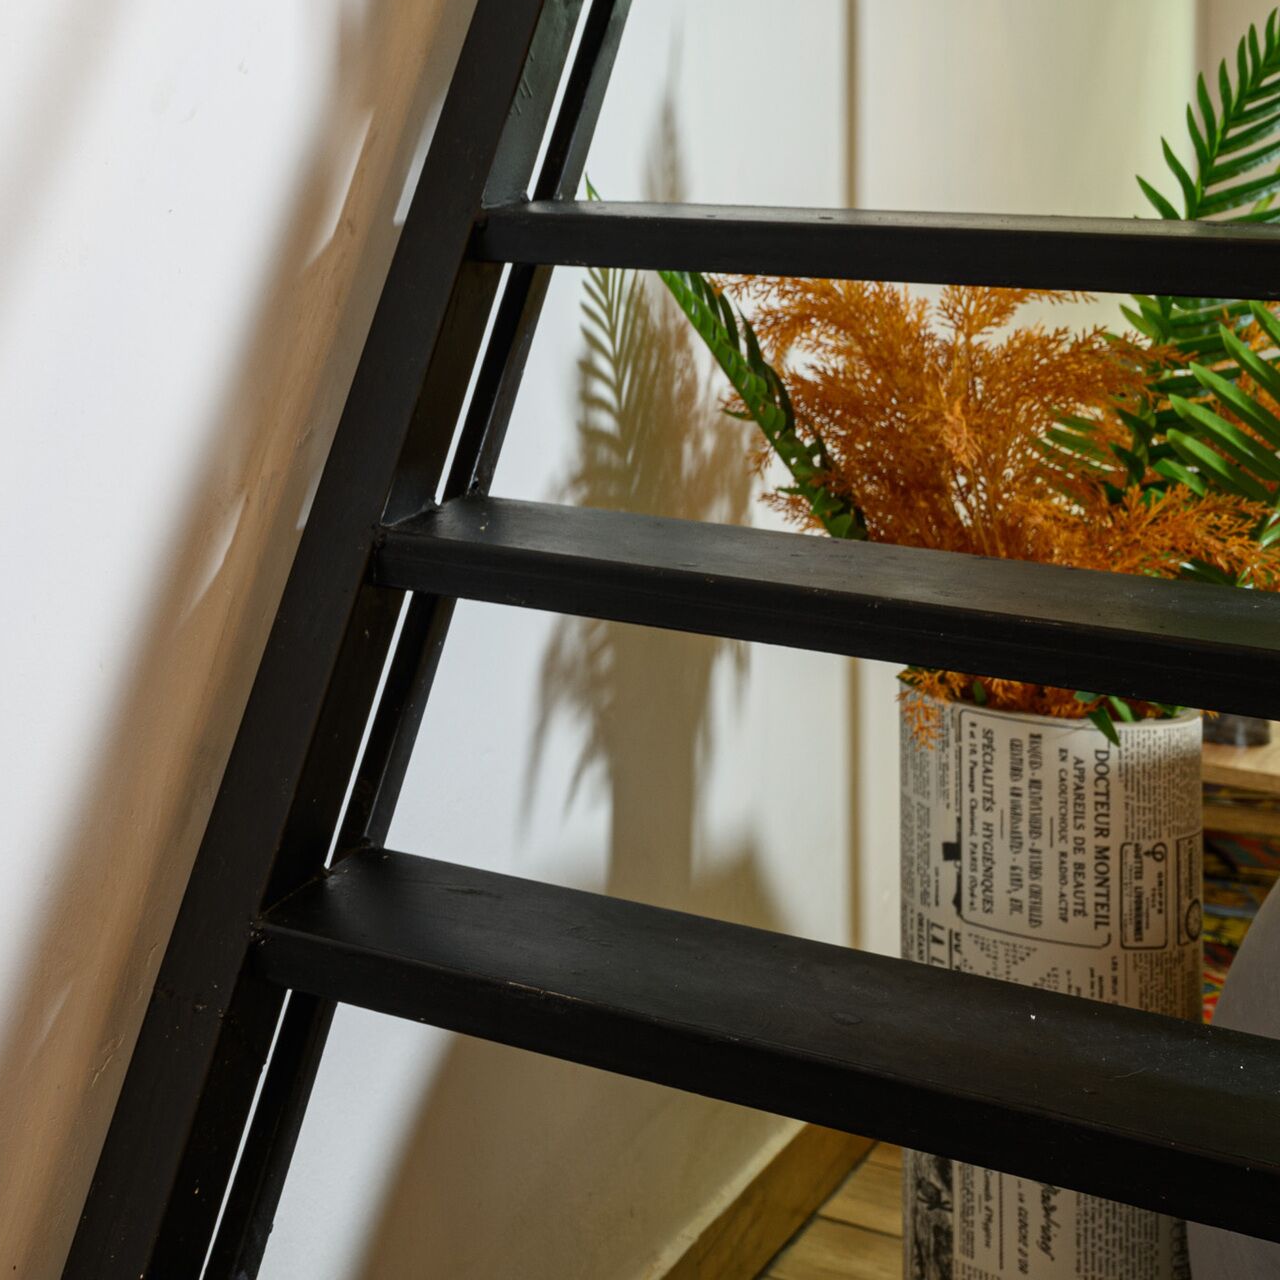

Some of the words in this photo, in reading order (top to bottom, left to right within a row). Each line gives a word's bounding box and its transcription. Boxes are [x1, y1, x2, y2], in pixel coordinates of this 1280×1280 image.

[982, 728, 997, 812] SPÉCIALITÉS
[1058, 748, 1068, 762] EN
[1073, 756, 1086, 830] APPAREILS
[1058, 768, 1068, 844] CAOUTCHOUC
[1093, 749, 1112, 838] DOCTEUR
[982, 821, 997, 915] HYGIÉNIQUES
[1073, 836, 1086, 856] DE
[1073, 862, 1088, 917] BEAUTÉ
[1093, 845, 1112, 931] MONTEIL
